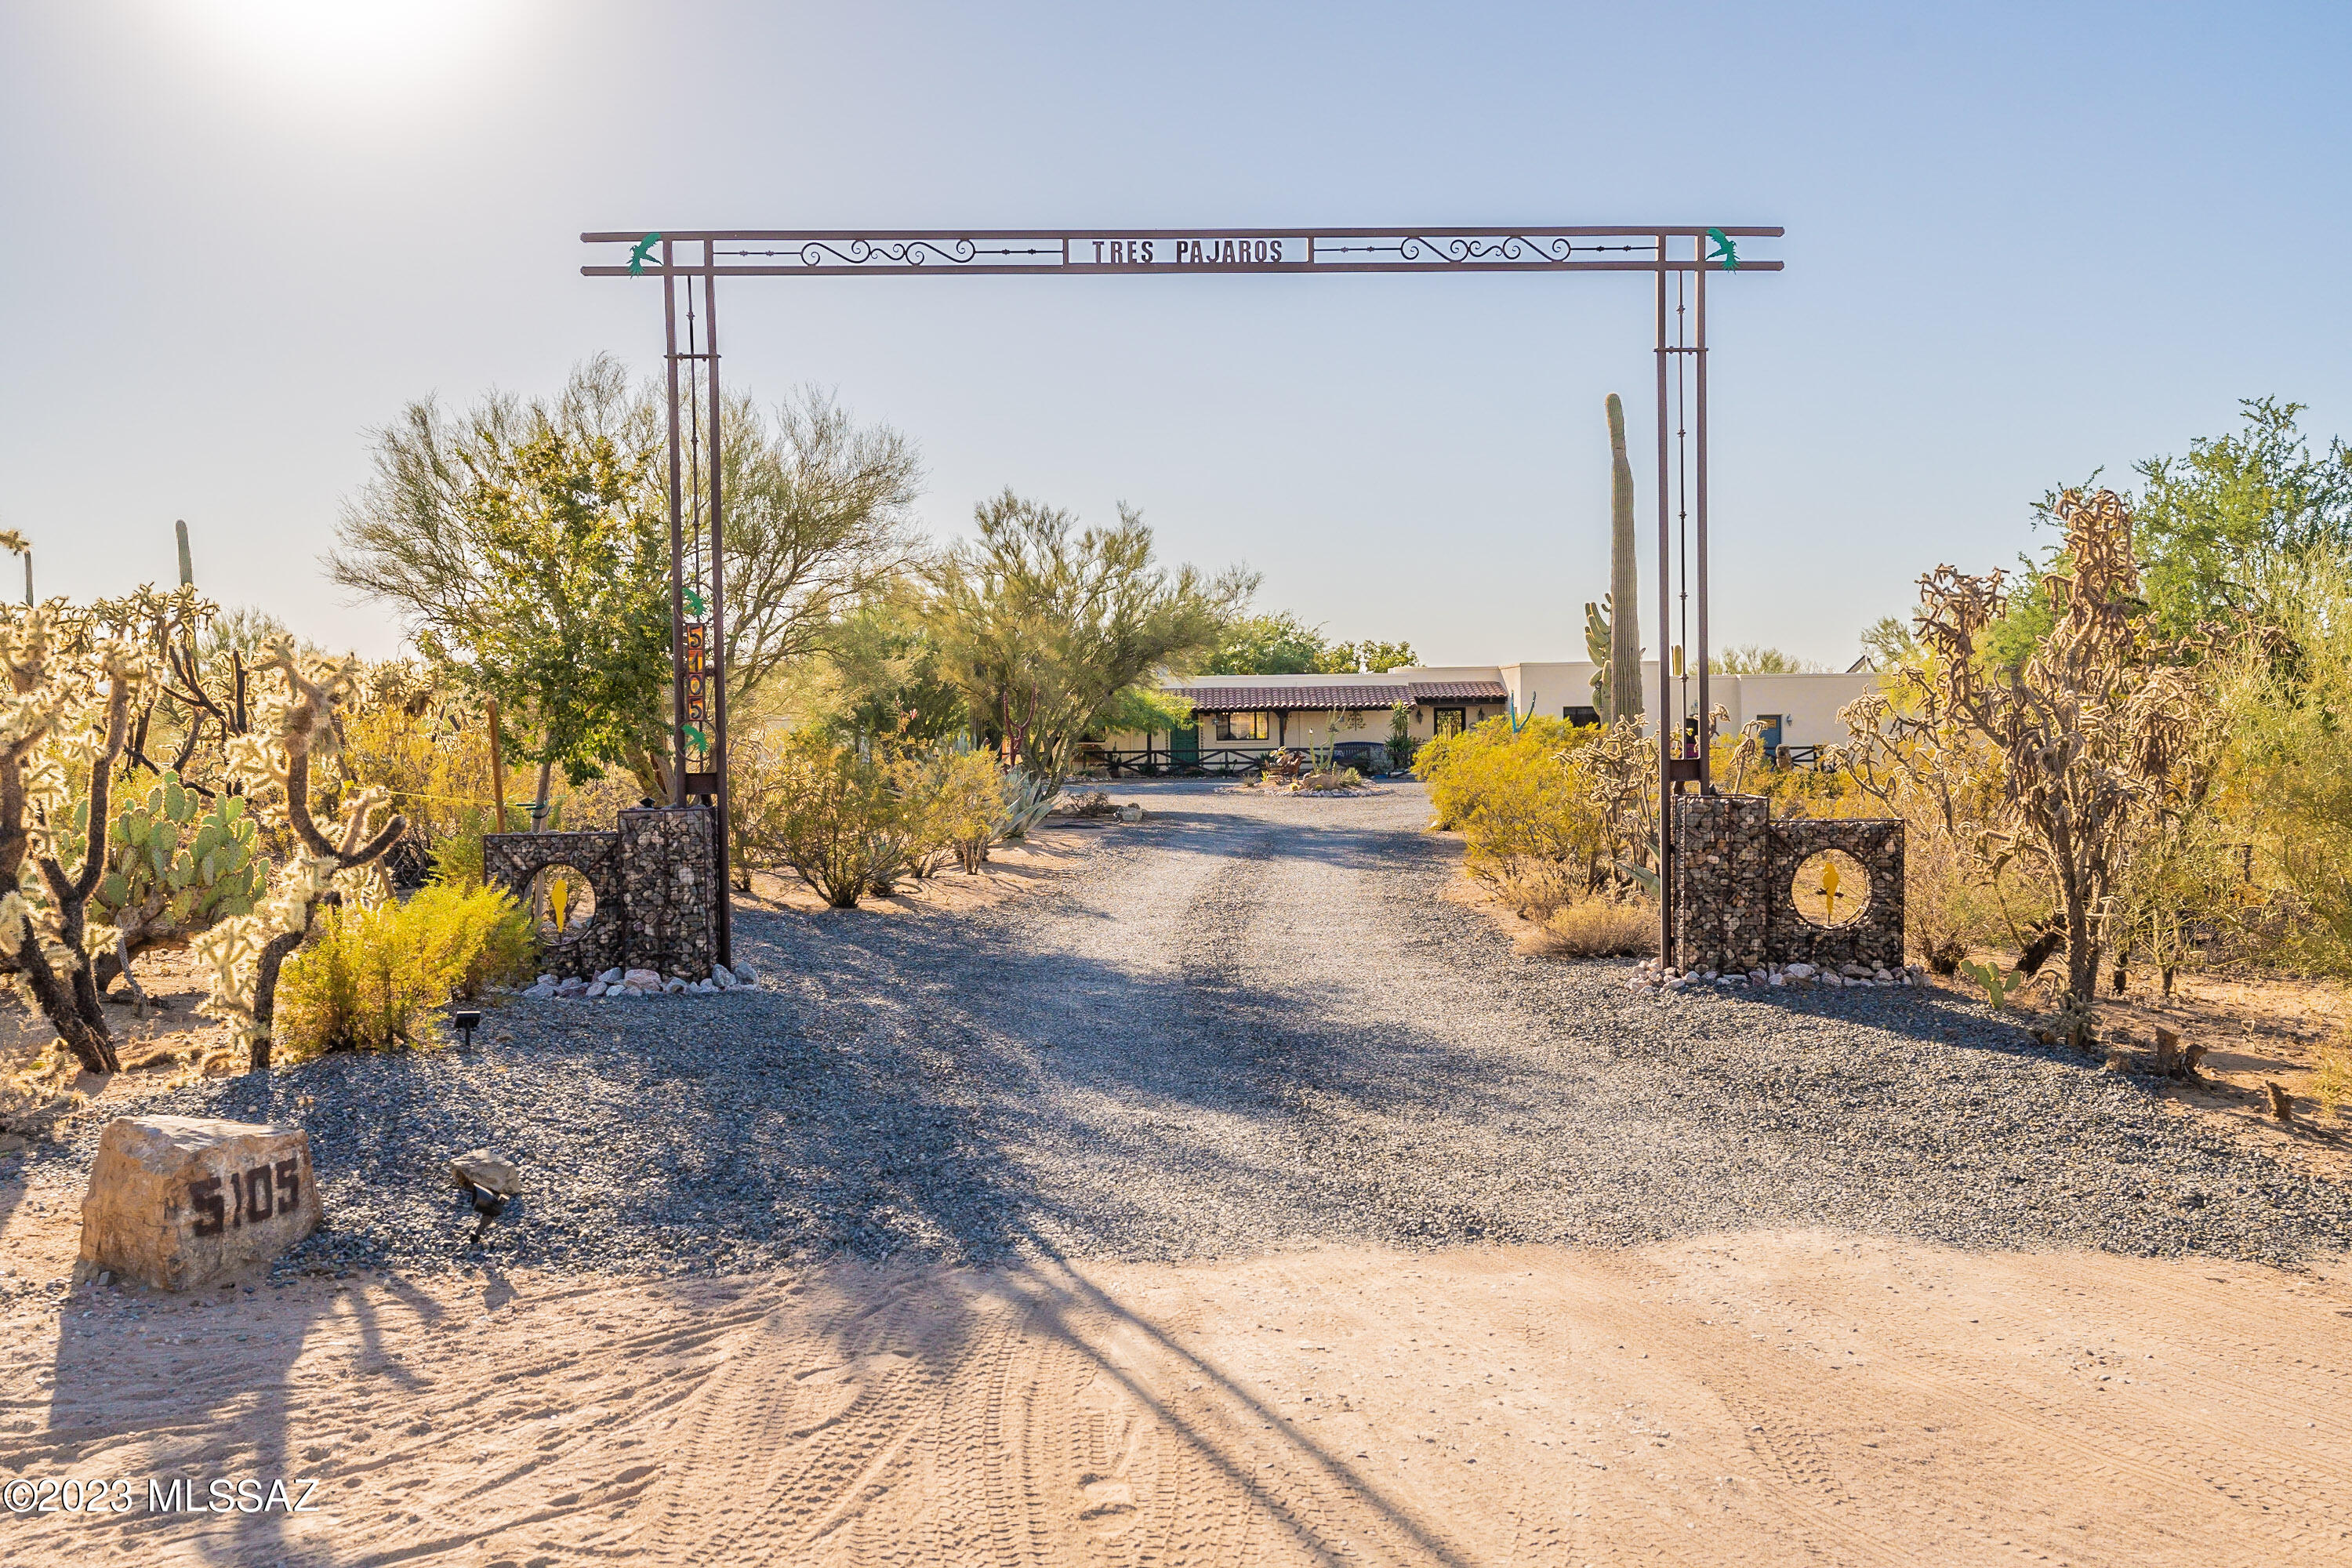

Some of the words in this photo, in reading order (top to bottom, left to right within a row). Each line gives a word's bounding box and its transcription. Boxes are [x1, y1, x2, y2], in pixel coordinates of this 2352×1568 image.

[1092, 241, 1153, 263] TRES
[1176, 240, 1282, 263] PAJAROS
[688, 626, 702, 720] 5105
[190, 1158, 300, 1236] 5105
